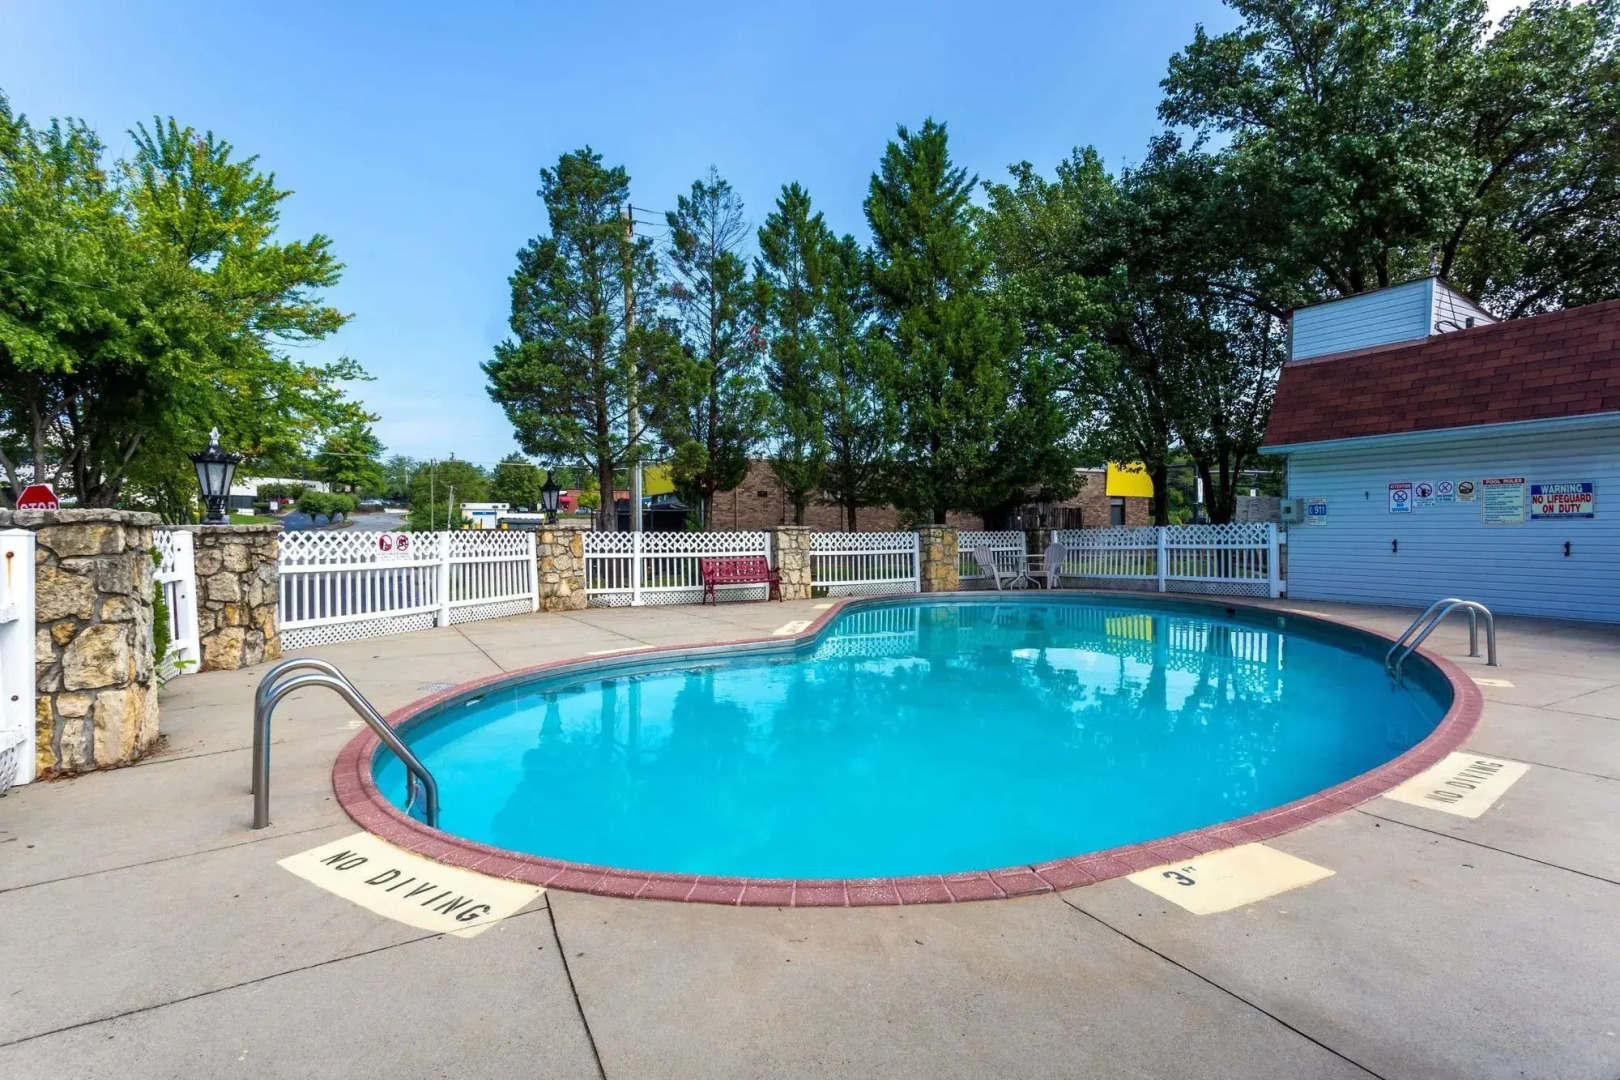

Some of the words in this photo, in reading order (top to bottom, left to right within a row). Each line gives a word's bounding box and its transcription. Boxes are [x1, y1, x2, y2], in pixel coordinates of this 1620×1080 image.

[1541, 484, 1583, 494] WARNING
[1532, 496, 1544, 504] NO
[1547, 494, 1592, 503] LIFEGUARD
[1314, 505, 1325, 514] 911
[1542, 504, 1554, 513] ON
[1559, 503, 1581, 513] DUTY
[1424, 790, 1463, 804] NO
[1445, 760, 1504, 790] DIVING
[1162, 871, 1196, 886] 3
[320, 850, 368, 871] NO
[364, 868, 491, 922] DIVING
